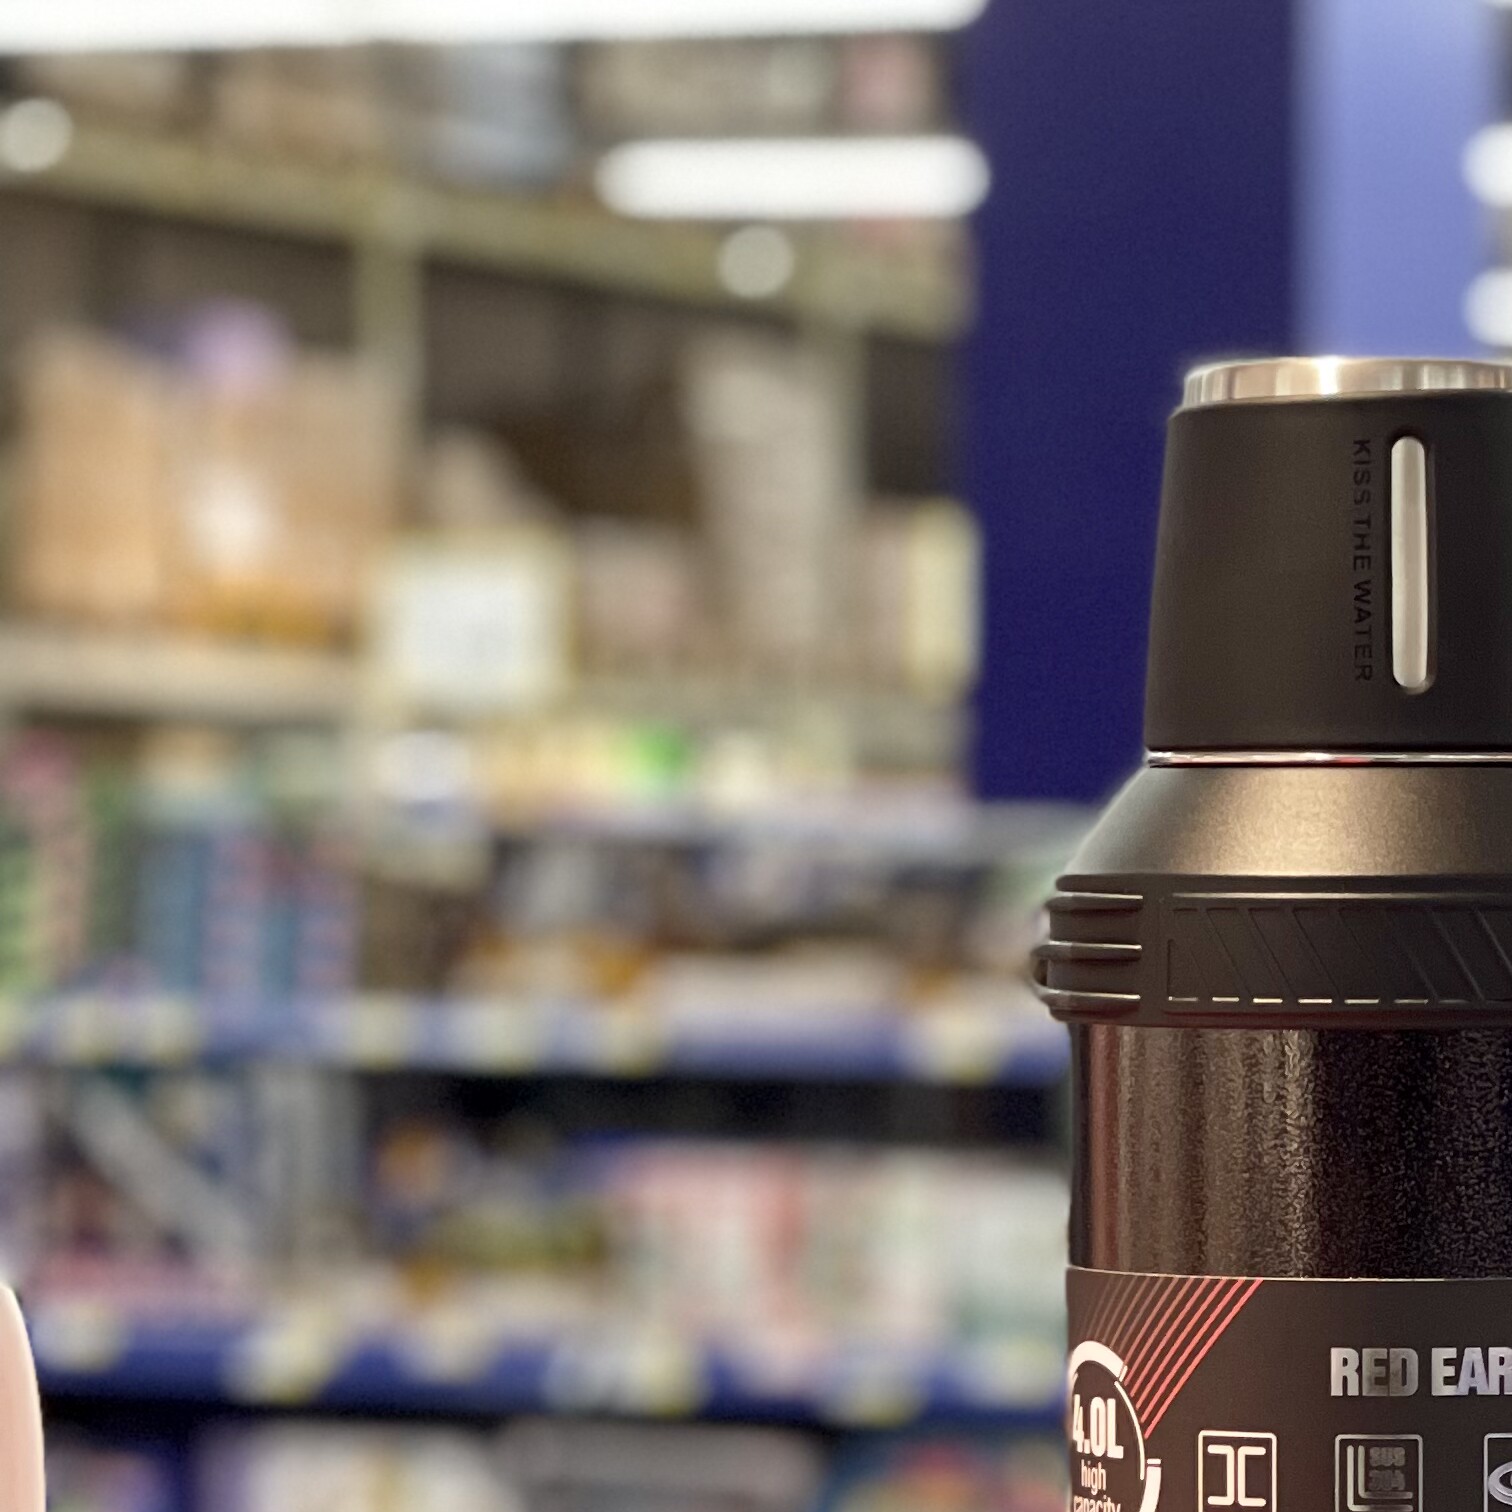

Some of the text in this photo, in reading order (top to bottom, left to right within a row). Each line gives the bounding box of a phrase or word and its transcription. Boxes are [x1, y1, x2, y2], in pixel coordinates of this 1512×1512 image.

[1353, 439, 1373, 682] KISS THE WATER
[1330, 1346, 1419, 1397] RED
[1072, 1394, 1124, 1459] 4.0L
[1081, 1459, 1106, 1494] high
